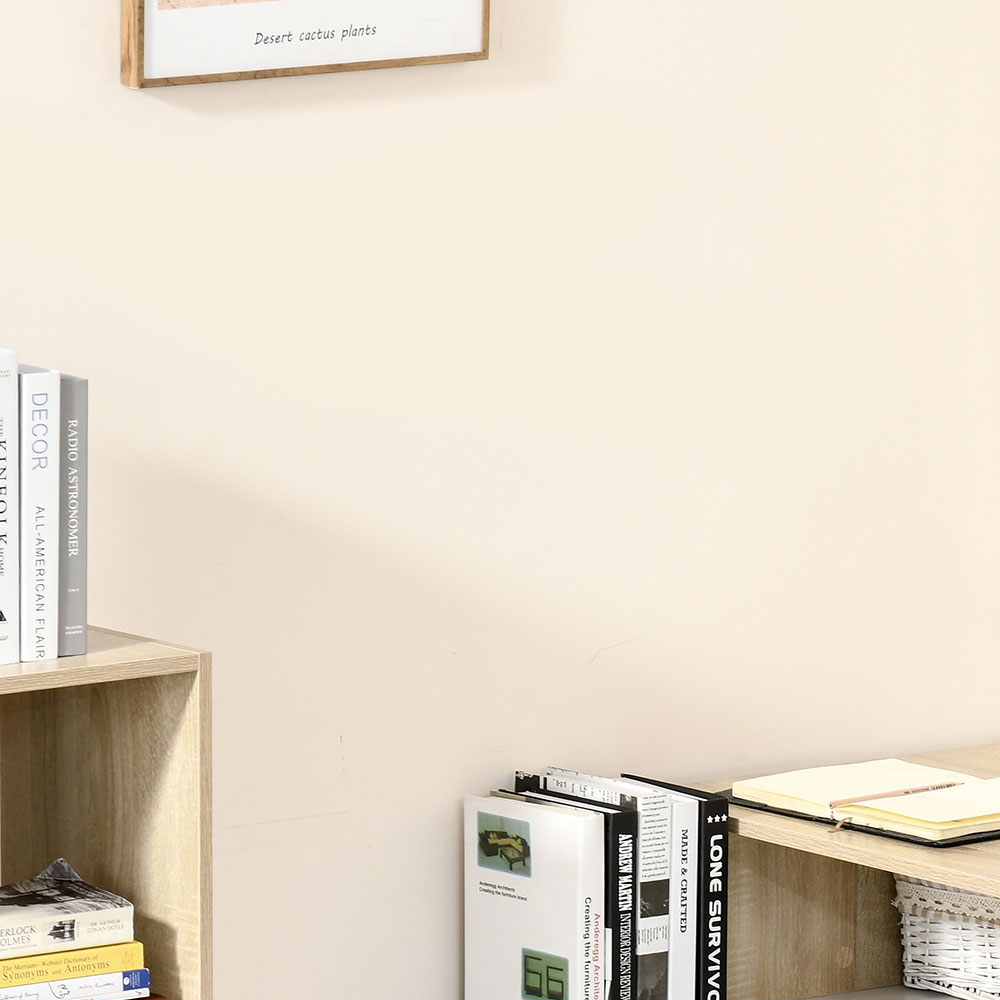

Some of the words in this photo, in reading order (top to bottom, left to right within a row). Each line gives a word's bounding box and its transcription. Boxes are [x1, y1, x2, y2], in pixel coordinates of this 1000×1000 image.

[254, 31, 293, 45] Desert
[299, 28, 335, 41] cactus
[341, 24, 376, 41] plants
[32, 393, 48, 471] DECOR
[68, 420, 78, 462] RADIO
[68, 468, 78, 558] ASTRONOMER
[35, 506, 44, 612] ALL-AMERICAN
[35, 619, 45, 659] FLAIR
[618, 834, 632, 874] ANDREW
[680, 829, 688, 864] MADE
[708, 834, 722, 893] LONE
[618, 875, 632, 911] MARTIN
[680, 879, 688, 933] CRAFTED
[584, 897, 592, 940] Creating
[620, 914, 632, 946] INTERIOR
[3, 968, 49, 983] Synonyms
[65, 961, 110, 973] Antonyms
[620, 947, 631, 975] DESIGN
